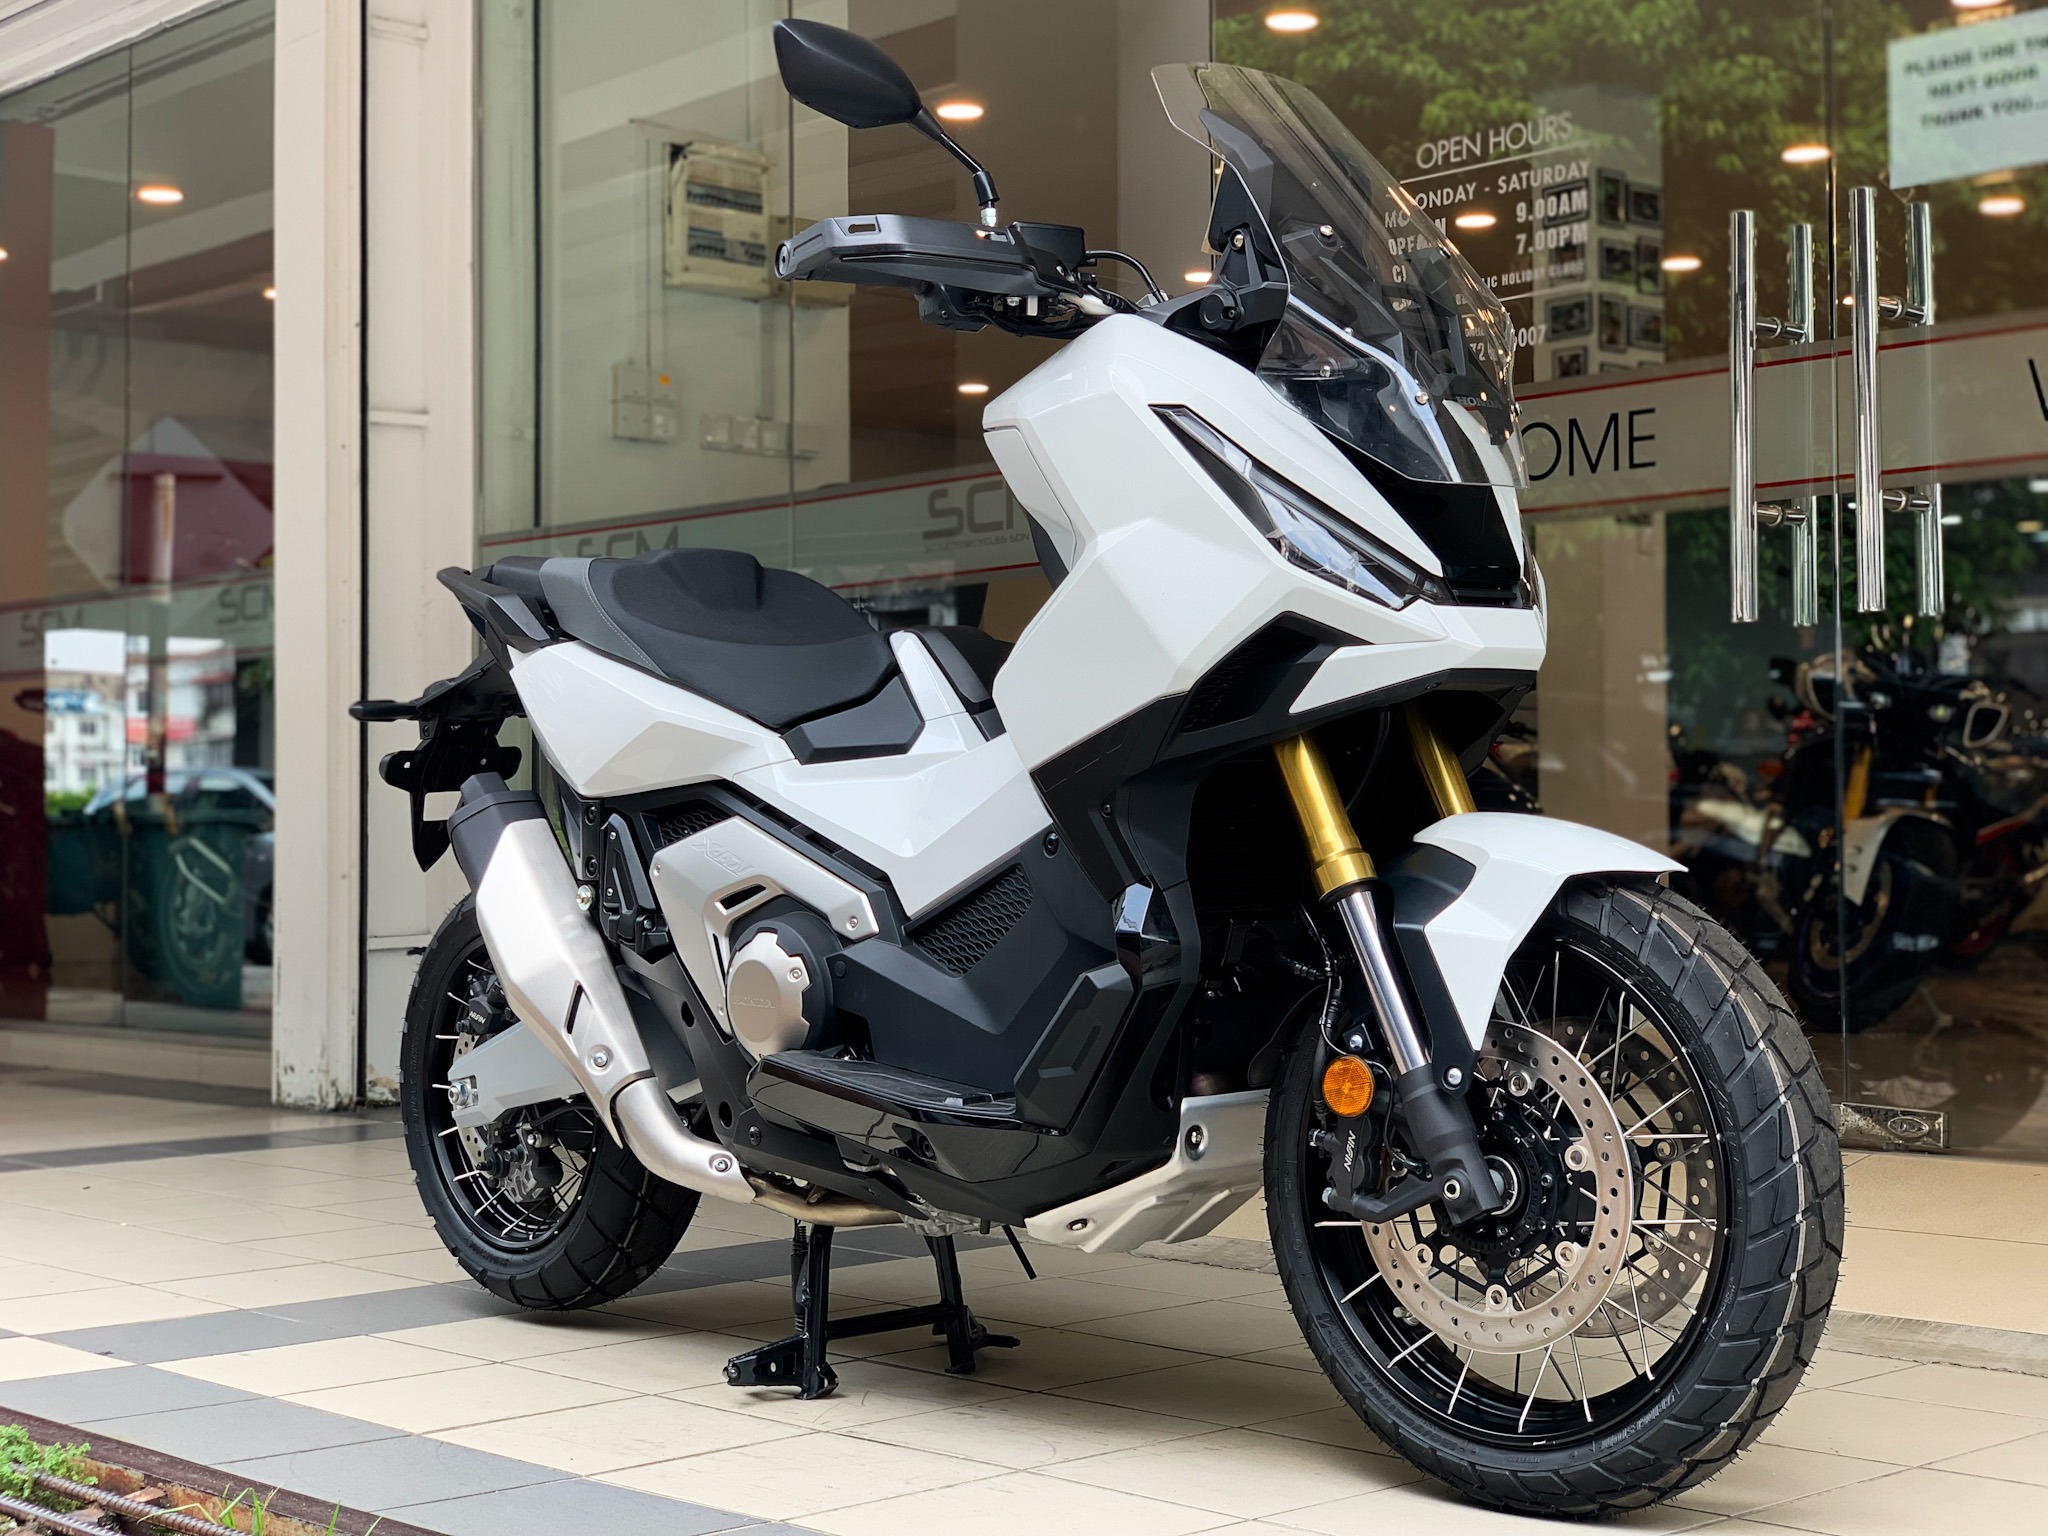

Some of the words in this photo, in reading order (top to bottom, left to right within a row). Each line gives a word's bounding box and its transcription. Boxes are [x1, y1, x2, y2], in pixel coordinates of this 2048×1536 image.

[1416, 131, 1482, 169] OPEN
[1489, 111, 1573, 154] HOURS
[1497, 158, 1592, 194] SATURDAY
[1515, 187, 1589, 224] 9.00AM
[1515, 222, 1589, 256] 7.00PM
